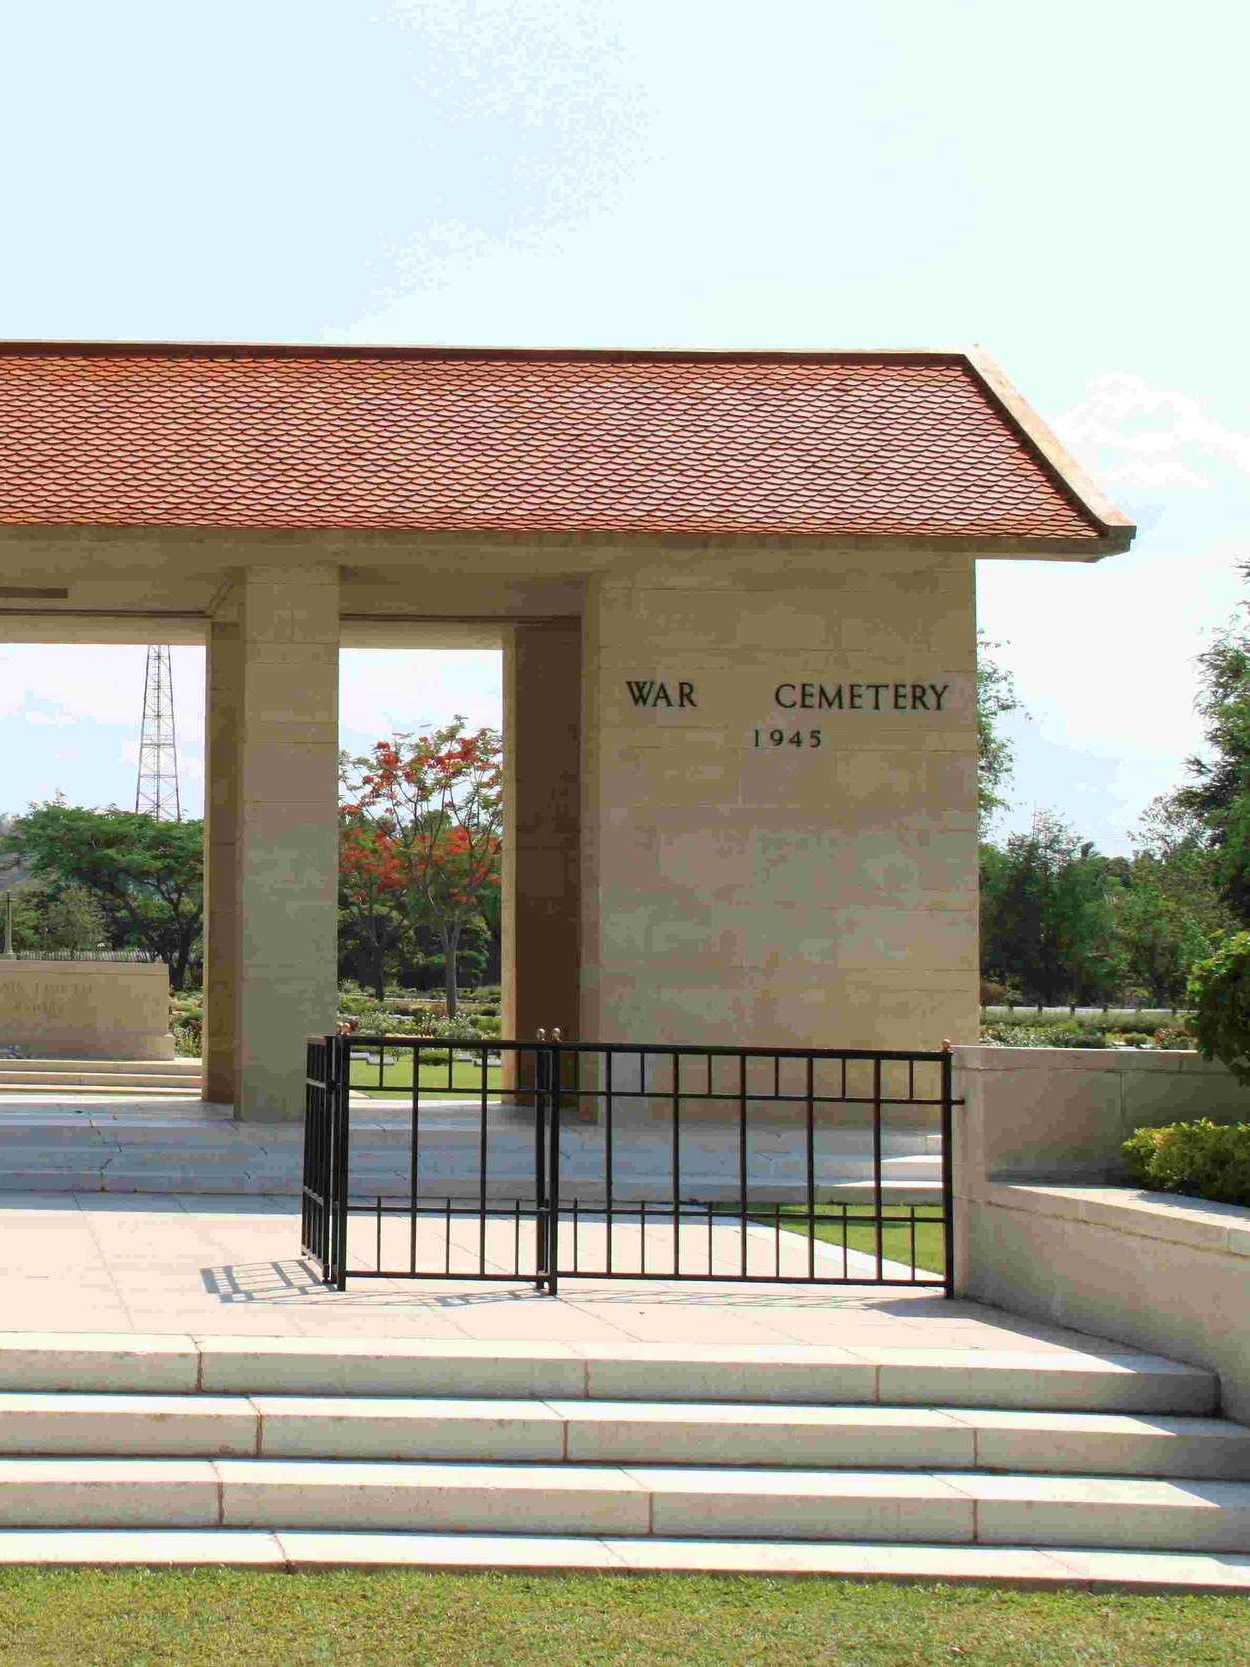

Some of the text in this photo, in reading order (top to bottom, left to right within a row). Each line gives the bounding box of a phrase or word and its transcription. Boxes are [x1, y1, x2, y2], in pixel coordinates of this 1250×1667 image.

[625, 680, 950, 711] WAR CEMETERY
[754, 728, 822, 749] 1945
